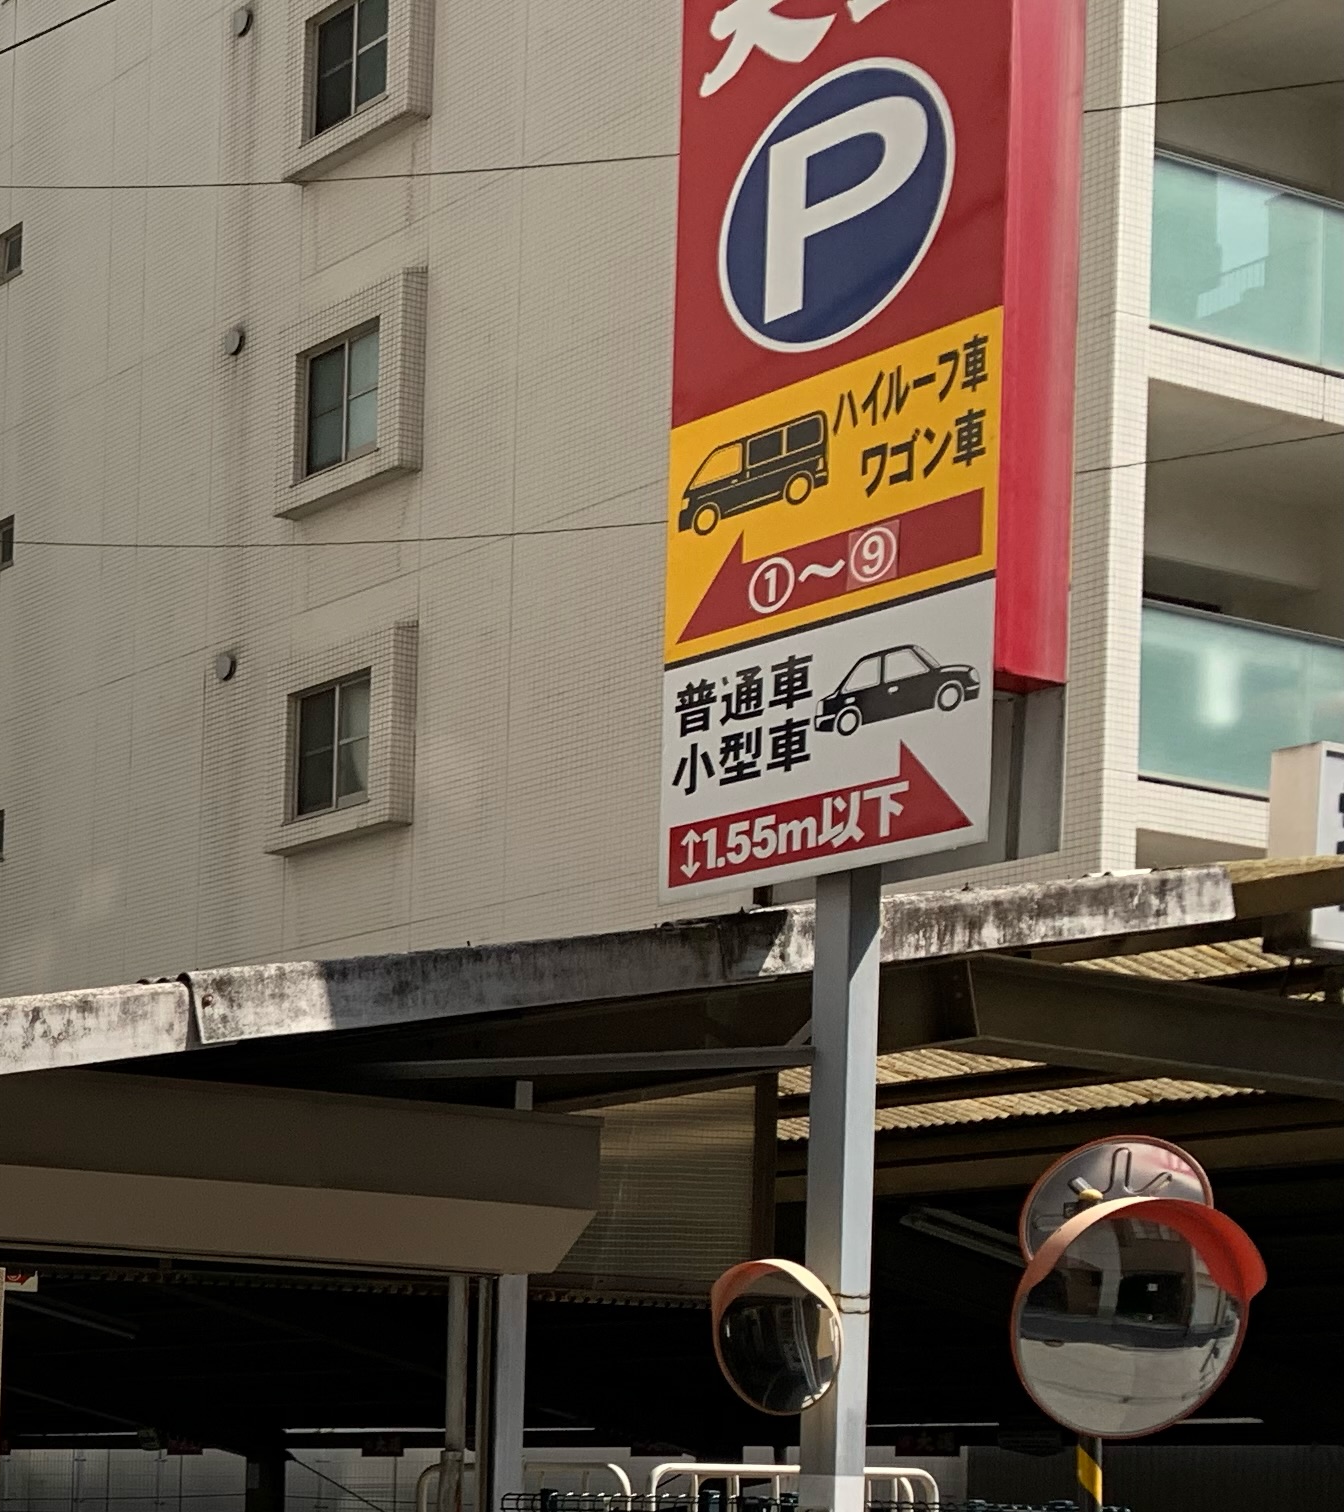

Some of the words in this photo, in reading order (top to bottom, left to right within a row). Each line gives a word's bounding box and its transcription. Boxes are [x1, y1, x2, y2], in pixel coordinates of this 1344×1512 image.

[764, 96, 928, 324] P
[833, 334, 989, 436] ハイルーフ車
[861, 409, 986, 498] ワゴン車
[675, 654, 813, 738] 普通車
[671, 717, 811, 796] 小型車
[702, 780, 910, 870] 1.55m以下
